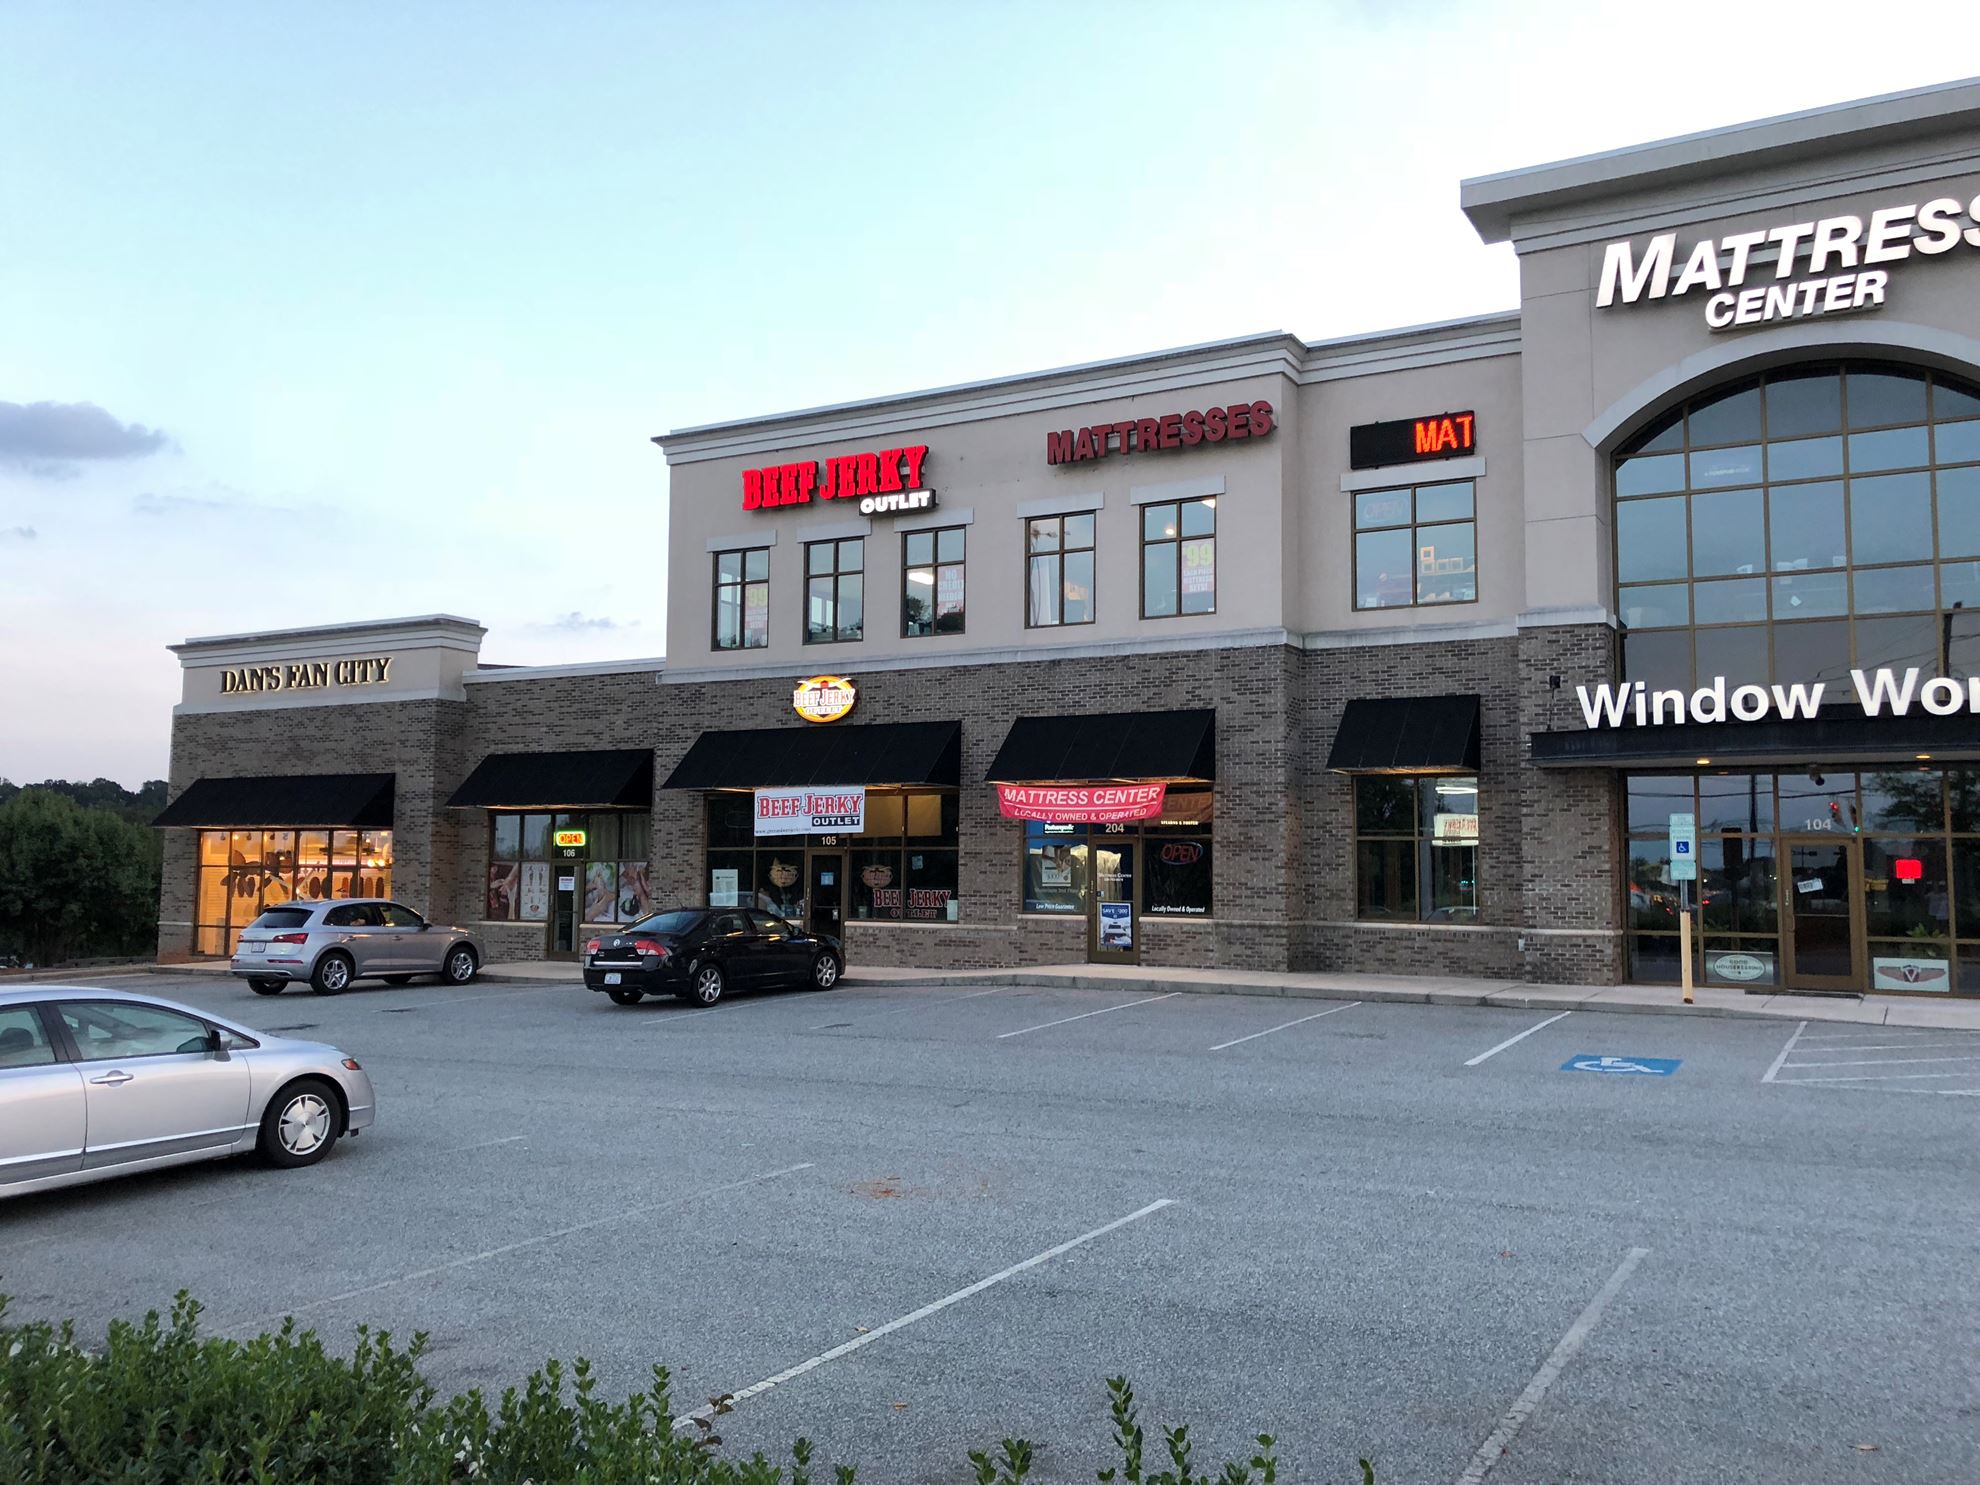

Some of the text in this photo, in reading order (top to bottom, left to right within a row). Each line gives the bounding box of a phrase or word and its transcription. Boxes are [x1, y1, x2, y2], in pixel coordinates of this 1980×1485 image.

[1705, 269, 1889, 329] CENTER
[1047, 400, 1274, 465] MATTRESSES
[1415, 415, 1475, 454] MAT
[742, 444, 929, 511] BEEF JERKY
[860, 490, 931, 515] OUTLET
[220, 657, 392, 694] DAN'S FAN CITY
[794, 688, 855, 706] BEEF JERKY
[1576, 676, 1825, 729] Window
[806, 706, 842, 714] OUTLET
[1004, 787, 1160, 804] MATTRESS CENTER
[758, 793, 863, 818] BEEF JERKY
[1014, 808, 1147, 820] LOCALLY OWNED & OPERATED
[813, 817, 860, 825] OUTLET
[1105, 823, 1125, 833] 204
[1804, 818, 1832, 831] 104
[558, 833, 584, 845] OPEN
[821, 836, 837, 845] 105
[562, 849, 576, 857] 106
[1162, 845, 1199, 862] OPEN
[907, 888, 952, 908] JERKY
[1151, 905, 1166, 914] Locally
[1186, 906, 1205, 914] Operated
